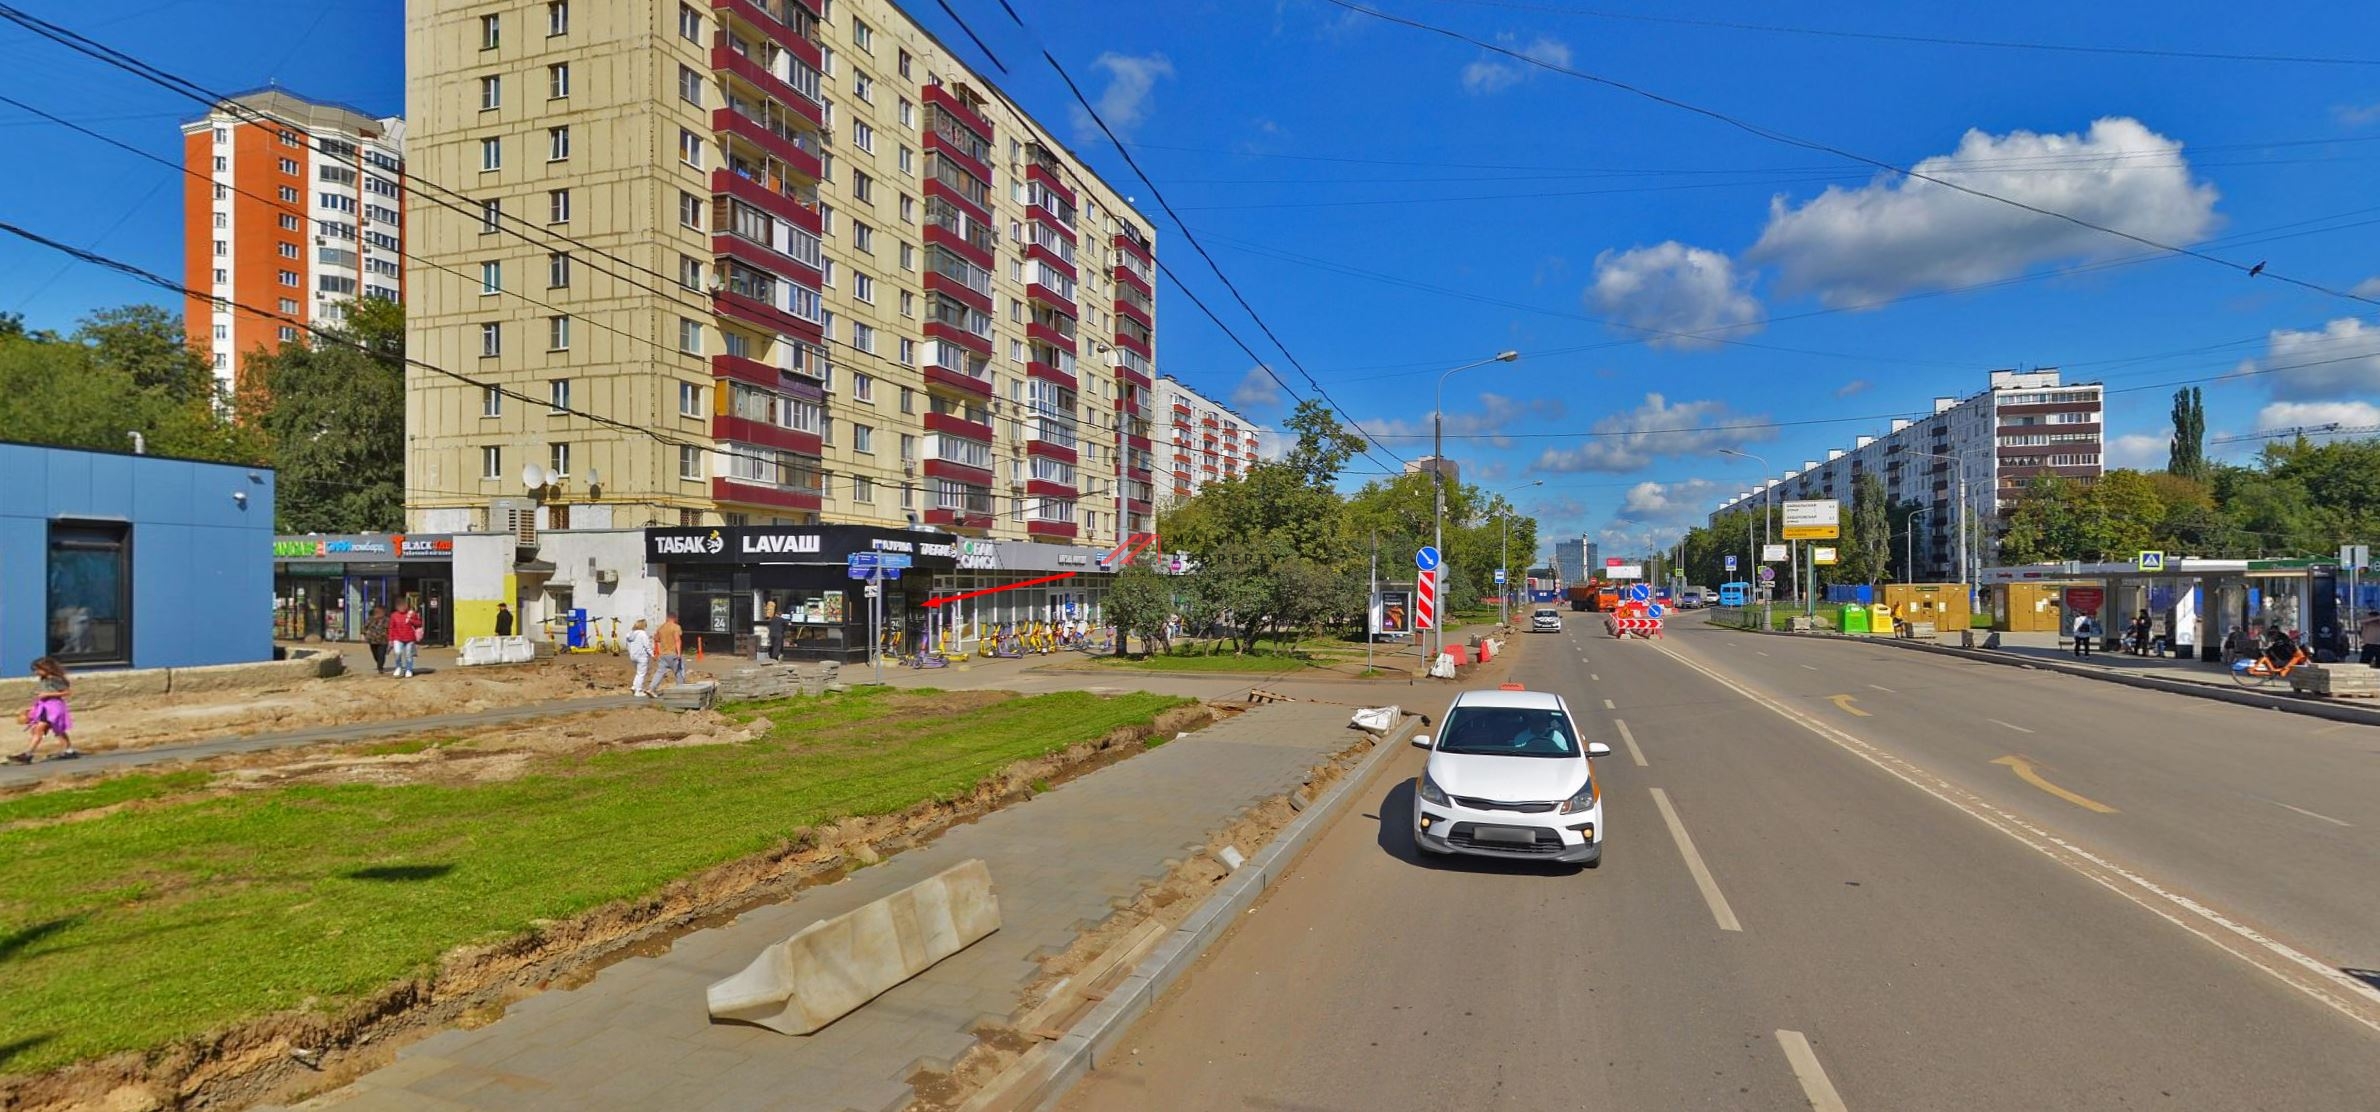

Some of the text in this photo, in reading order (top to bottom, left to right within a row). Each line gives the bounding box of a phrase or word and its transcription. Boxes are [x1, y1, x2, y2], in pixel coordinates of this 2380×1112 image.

[401, 540, 432, 551] BLACK
[655, 536, 706, 554] ТАБАК
[742, 535, 821, 553] LAVAШ
[714, 617, 726, 628] 24
